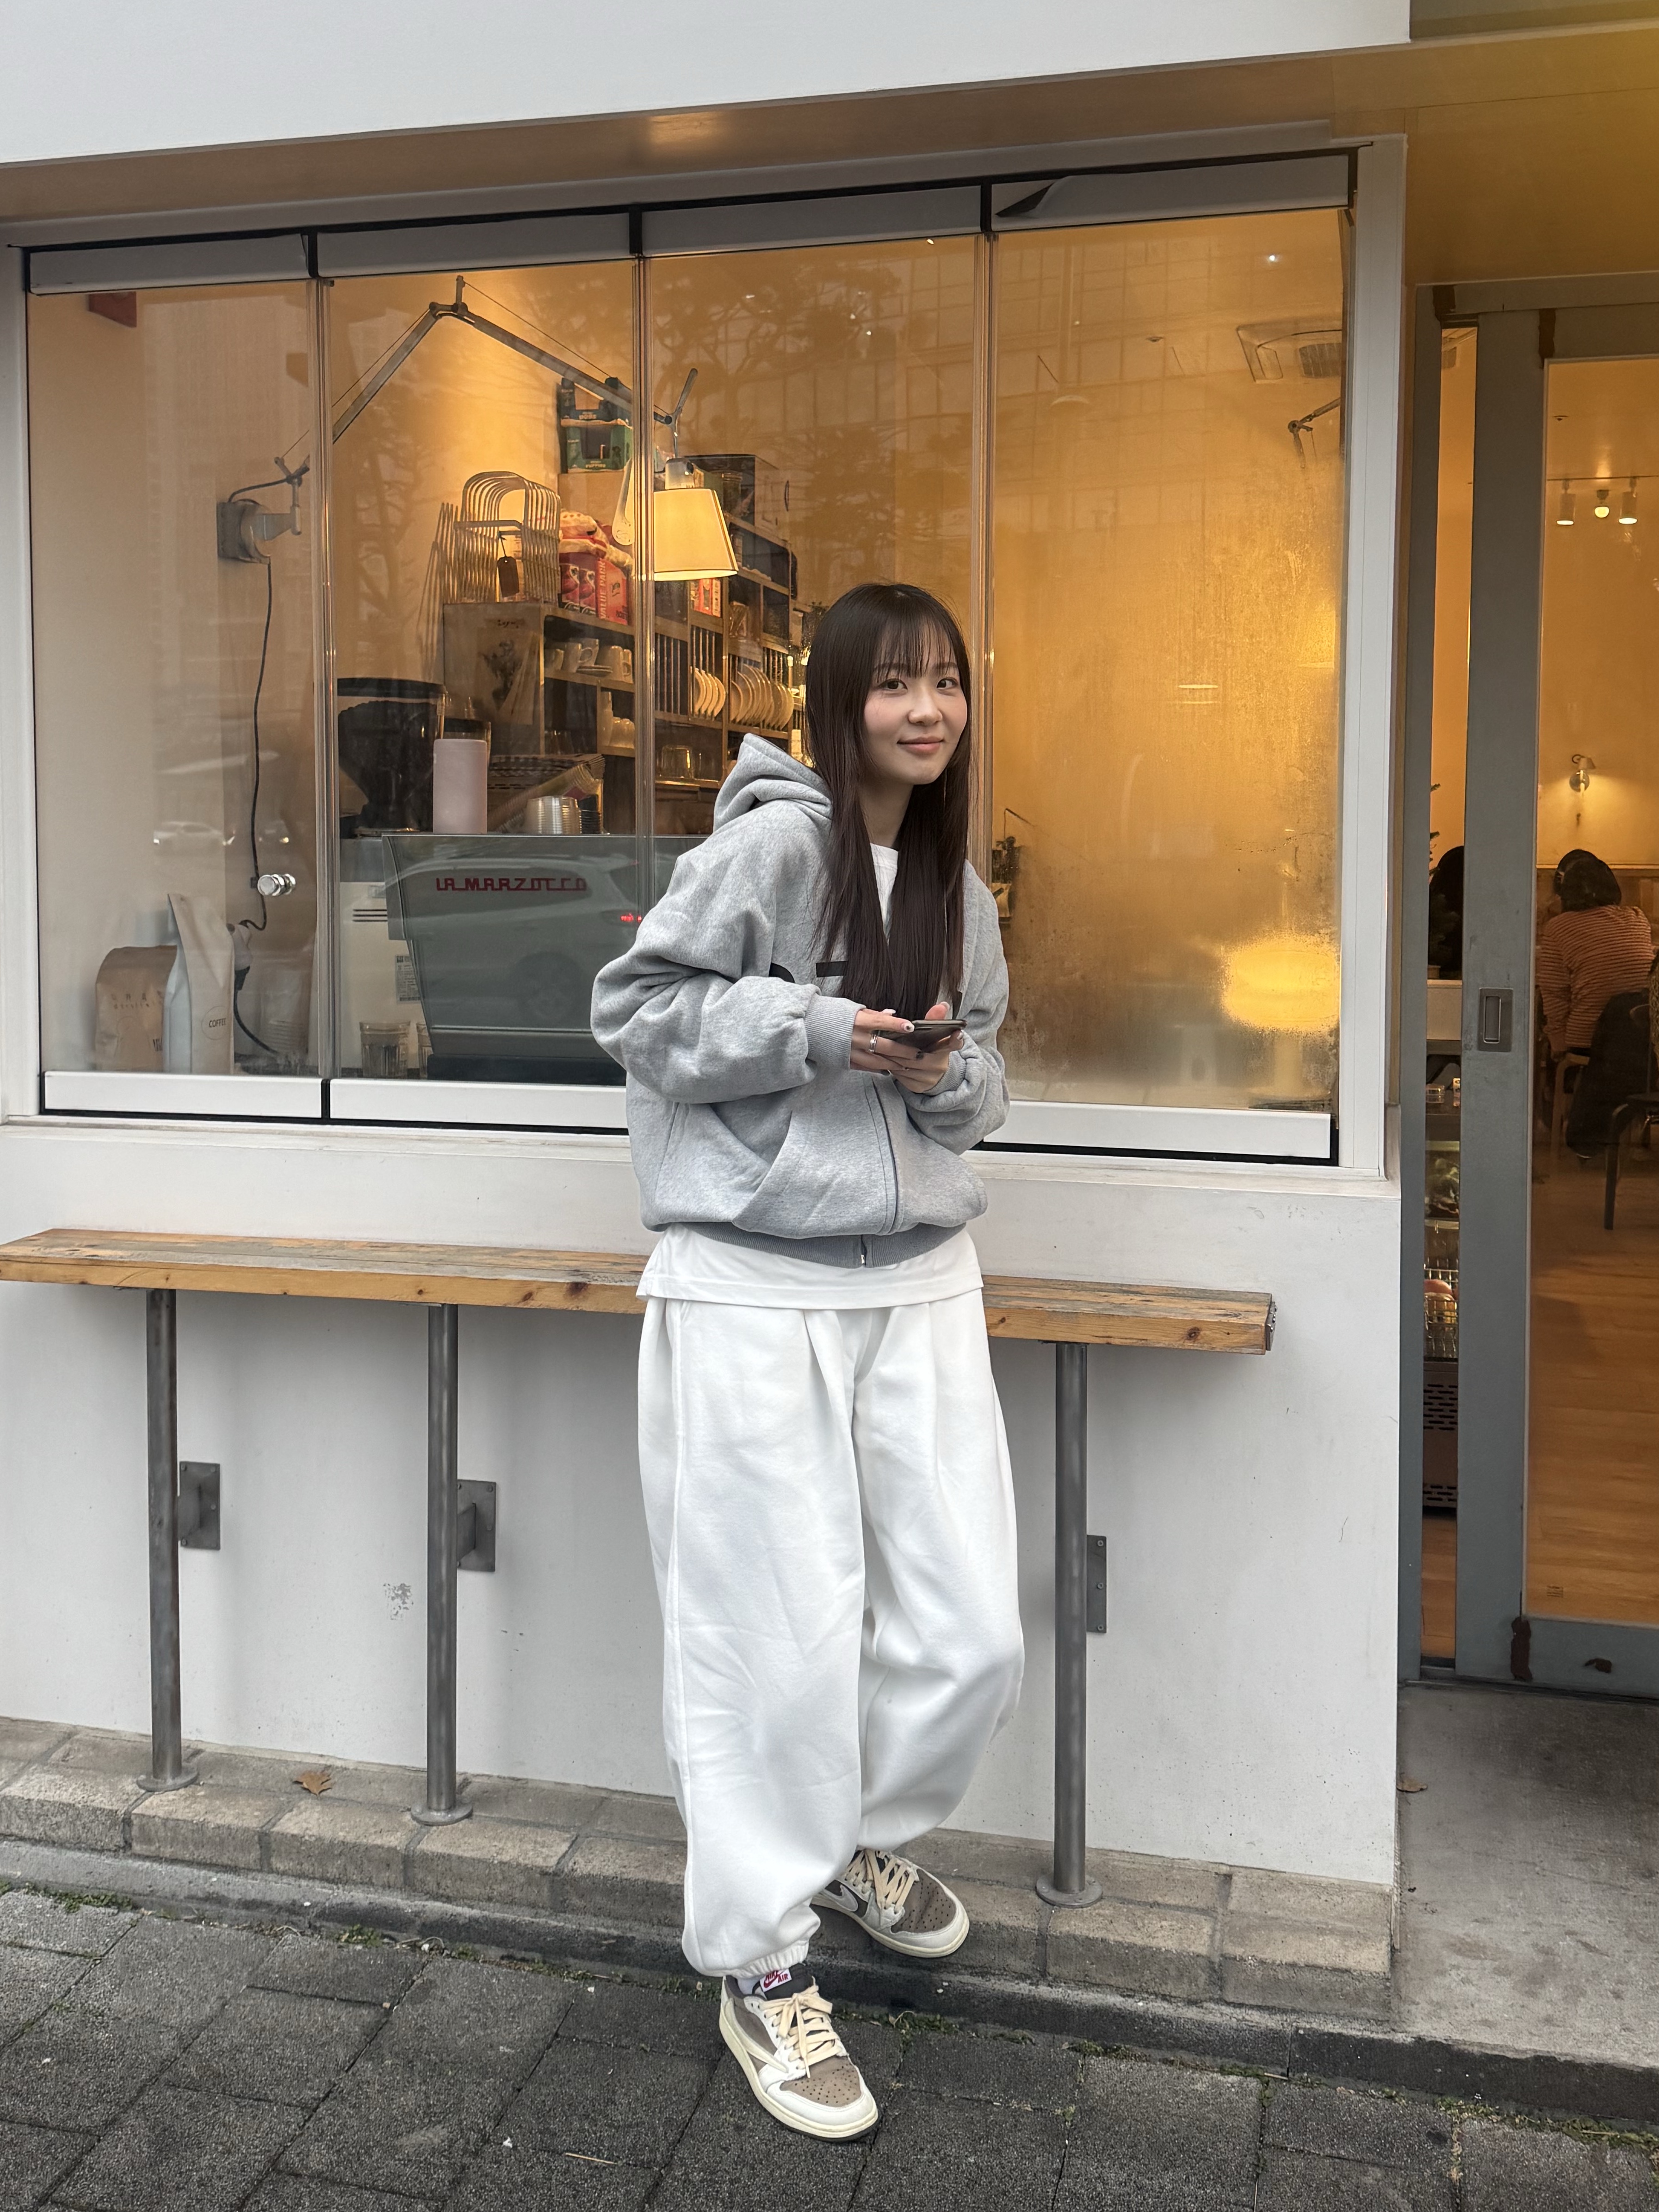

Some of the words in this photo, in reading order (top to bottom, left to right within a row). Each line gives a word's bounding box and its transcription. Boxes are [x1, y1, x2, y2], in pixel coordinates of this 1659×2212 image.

[436, 878, 455, 891] LA
[209, 1018, 226, 1028] COFFEE
[778, 1973, 788, 1983] AIR
